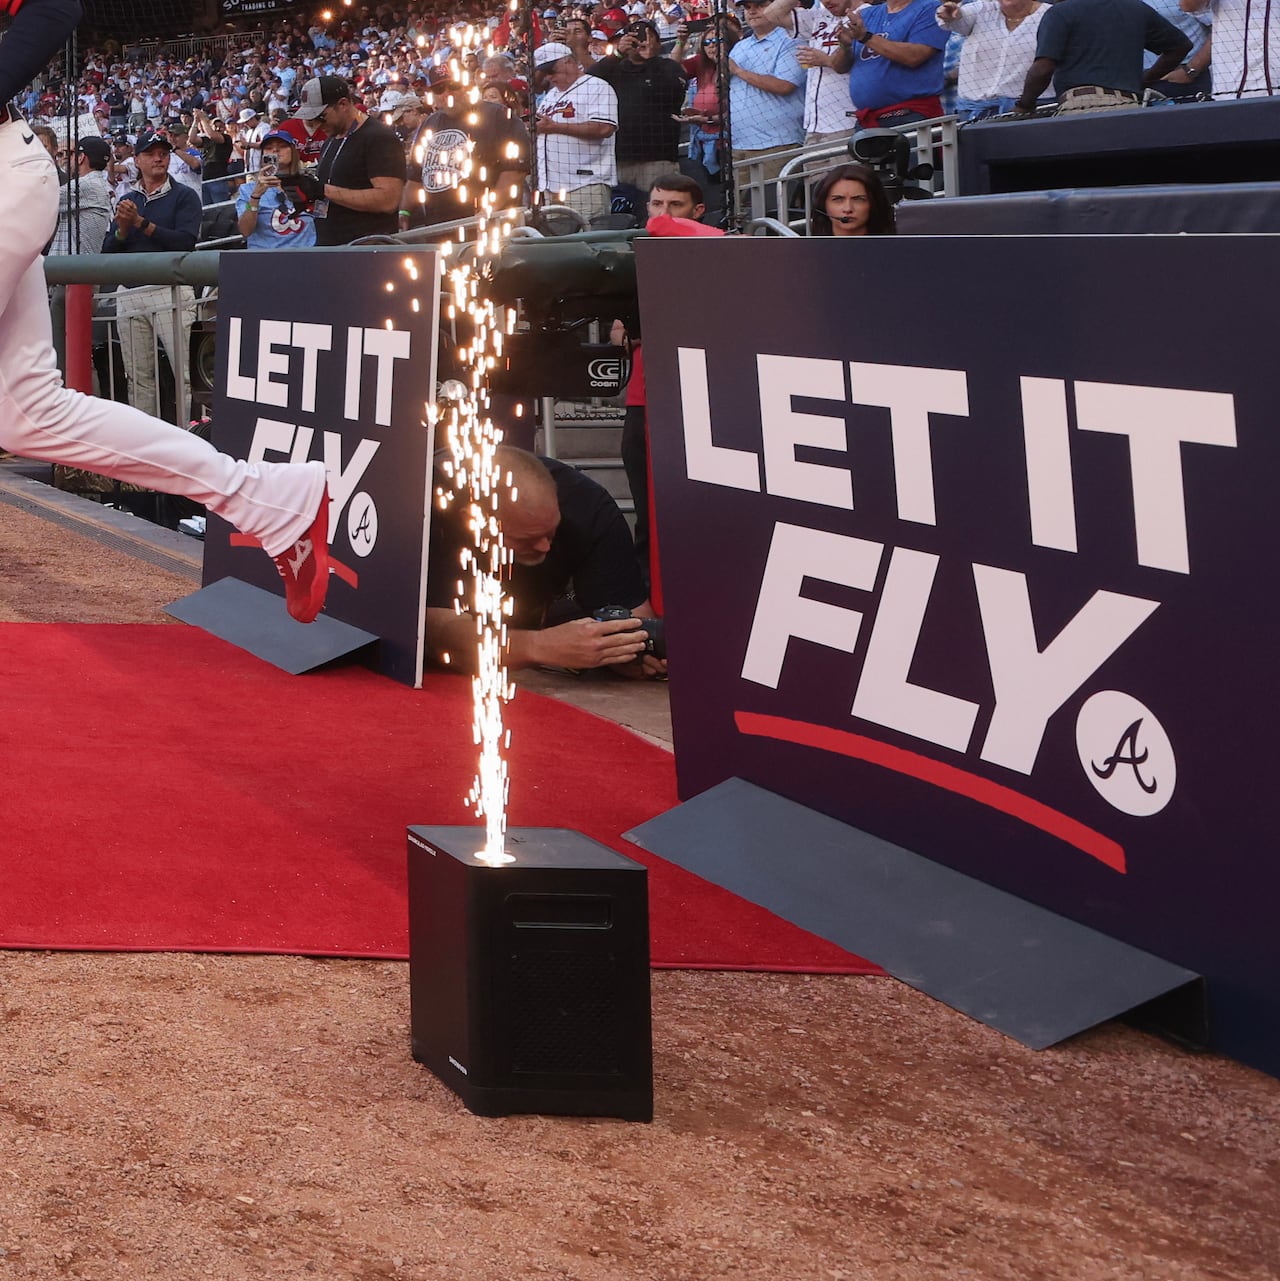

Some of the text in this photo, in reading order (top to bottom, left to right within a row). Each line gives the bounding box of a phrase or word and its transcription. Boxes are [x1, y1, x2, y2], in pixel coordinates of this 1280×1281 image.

[225, 317, 411, 426] LET IT
[677, 346, 1239, 576] LET IT
[739, 521, 1162, 777] FLY
